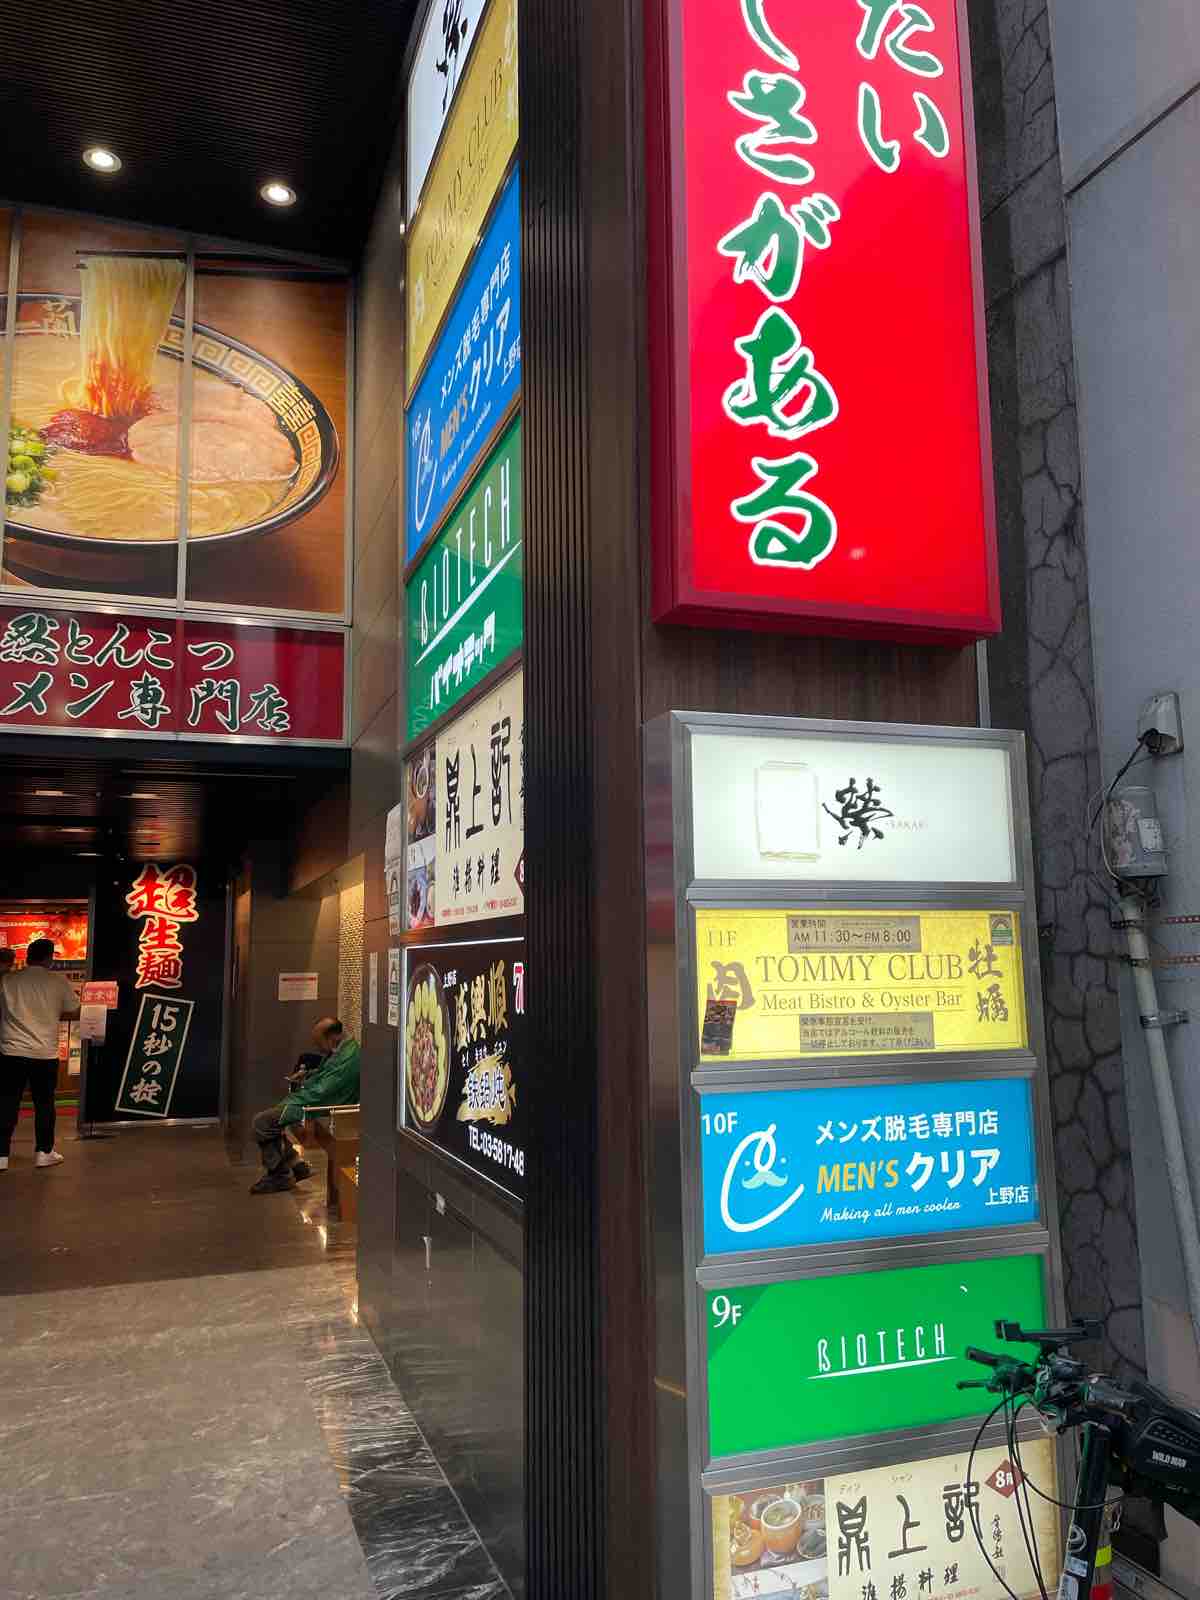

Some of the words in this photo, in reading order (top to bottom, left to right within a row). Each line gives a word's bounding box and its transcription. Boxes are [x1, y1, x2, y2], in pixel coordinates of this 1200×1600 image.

[0, 613, 234, 670] 然とんこつ
[0, 670, 290, 733] メン専門店
[756, 954, 877, 983] TOMMY
[888, 952, 964, 980] CLUB
[762, 994, 803, 1011] Meat
[809, 992, 856, 1008] Bistro
[861, 993, 876, 1007] &
[880, 991, 930, 1011] Oyster
[935, 989, 962, 1006] Bar
[129, 1003, 180, 1106] 15秒の掟
[703, 1112, 738, 1135] 10F
[816, 1109, 1000, 1146] メンズ脱毛専門店
[816, 1158, 899, 1196] MEN'S
[905, 1147, 1001, 1193] クリア
[819, 1207, 870, 1224] Making
[874, 1201, 894, 1218] all
[896, 1204, 921, 1216] men
[985, 1185, 1031, 1208] 上野店
[712, 1295, 743, 1328] 9F
[817, 1323, 945, 1372] BIOTECH
